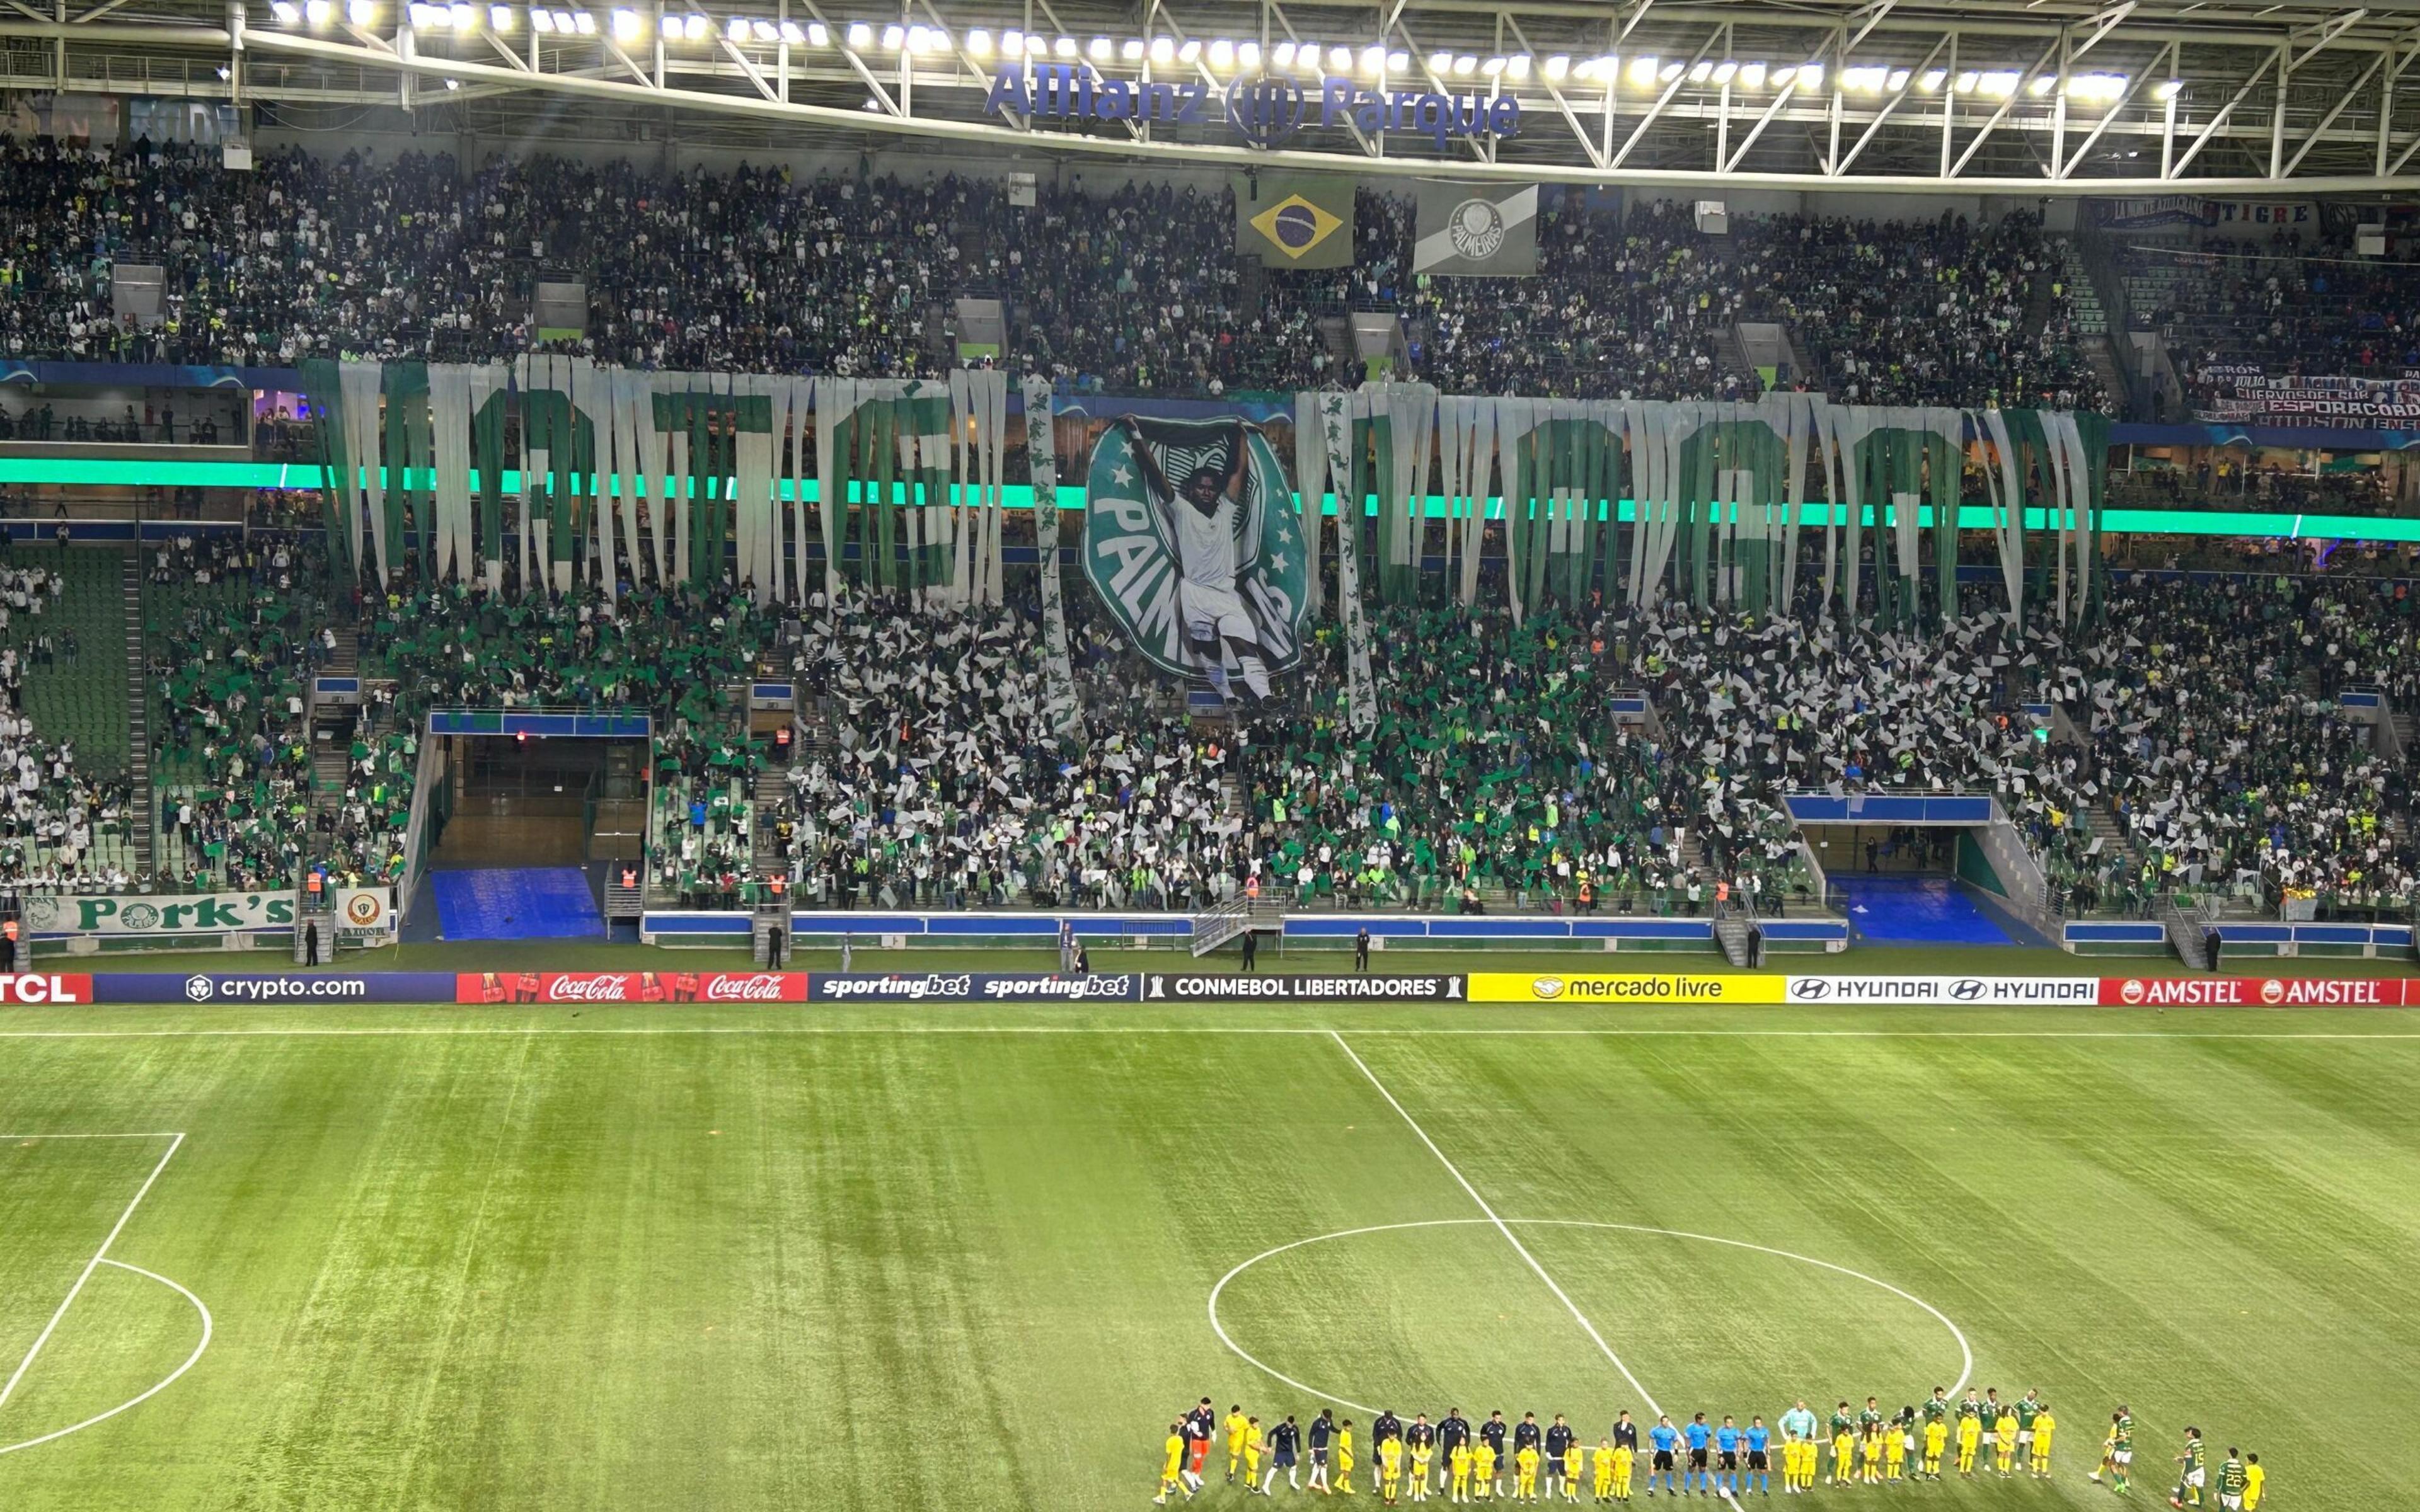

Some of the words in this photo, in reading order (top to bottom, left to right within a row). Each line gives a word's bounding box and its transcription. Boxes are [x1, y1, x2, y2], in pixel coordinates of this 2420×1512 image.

[984, 64, 1211, 123] Allianz
[1322, 76, 1520, 149] Parque
[2220, 202, 2308, 223] TIGRE
[1453, 225, 1501, 256] PALMEIRAS
[1093, 498, 1293, 669] PALMAS
[221, 978, 365, 999] crypto.com
[550, 975, 626, 1000] Coca-Cola
[708, 975, 782, 999] Coca-Cola
[823, 974, 971, 999] sportingbet
[984, 975, 1130, 999] sportingbet
[1176, 978, 1289, 996] CONMEBOL
[1294, 978, 1436, 996] LIBERTADORES
[1570, 977, 1670, 997] mercado
[1676, 977, 1722, 997] livre
[1838, 982, 1938, 997] HYUNDAI
[1994, 983, 2094, 999] HYUNDAI
[2146, 981, 2239, 1003] AMSTEL
[2286, 980, 2377, 1003] AMSTEL
